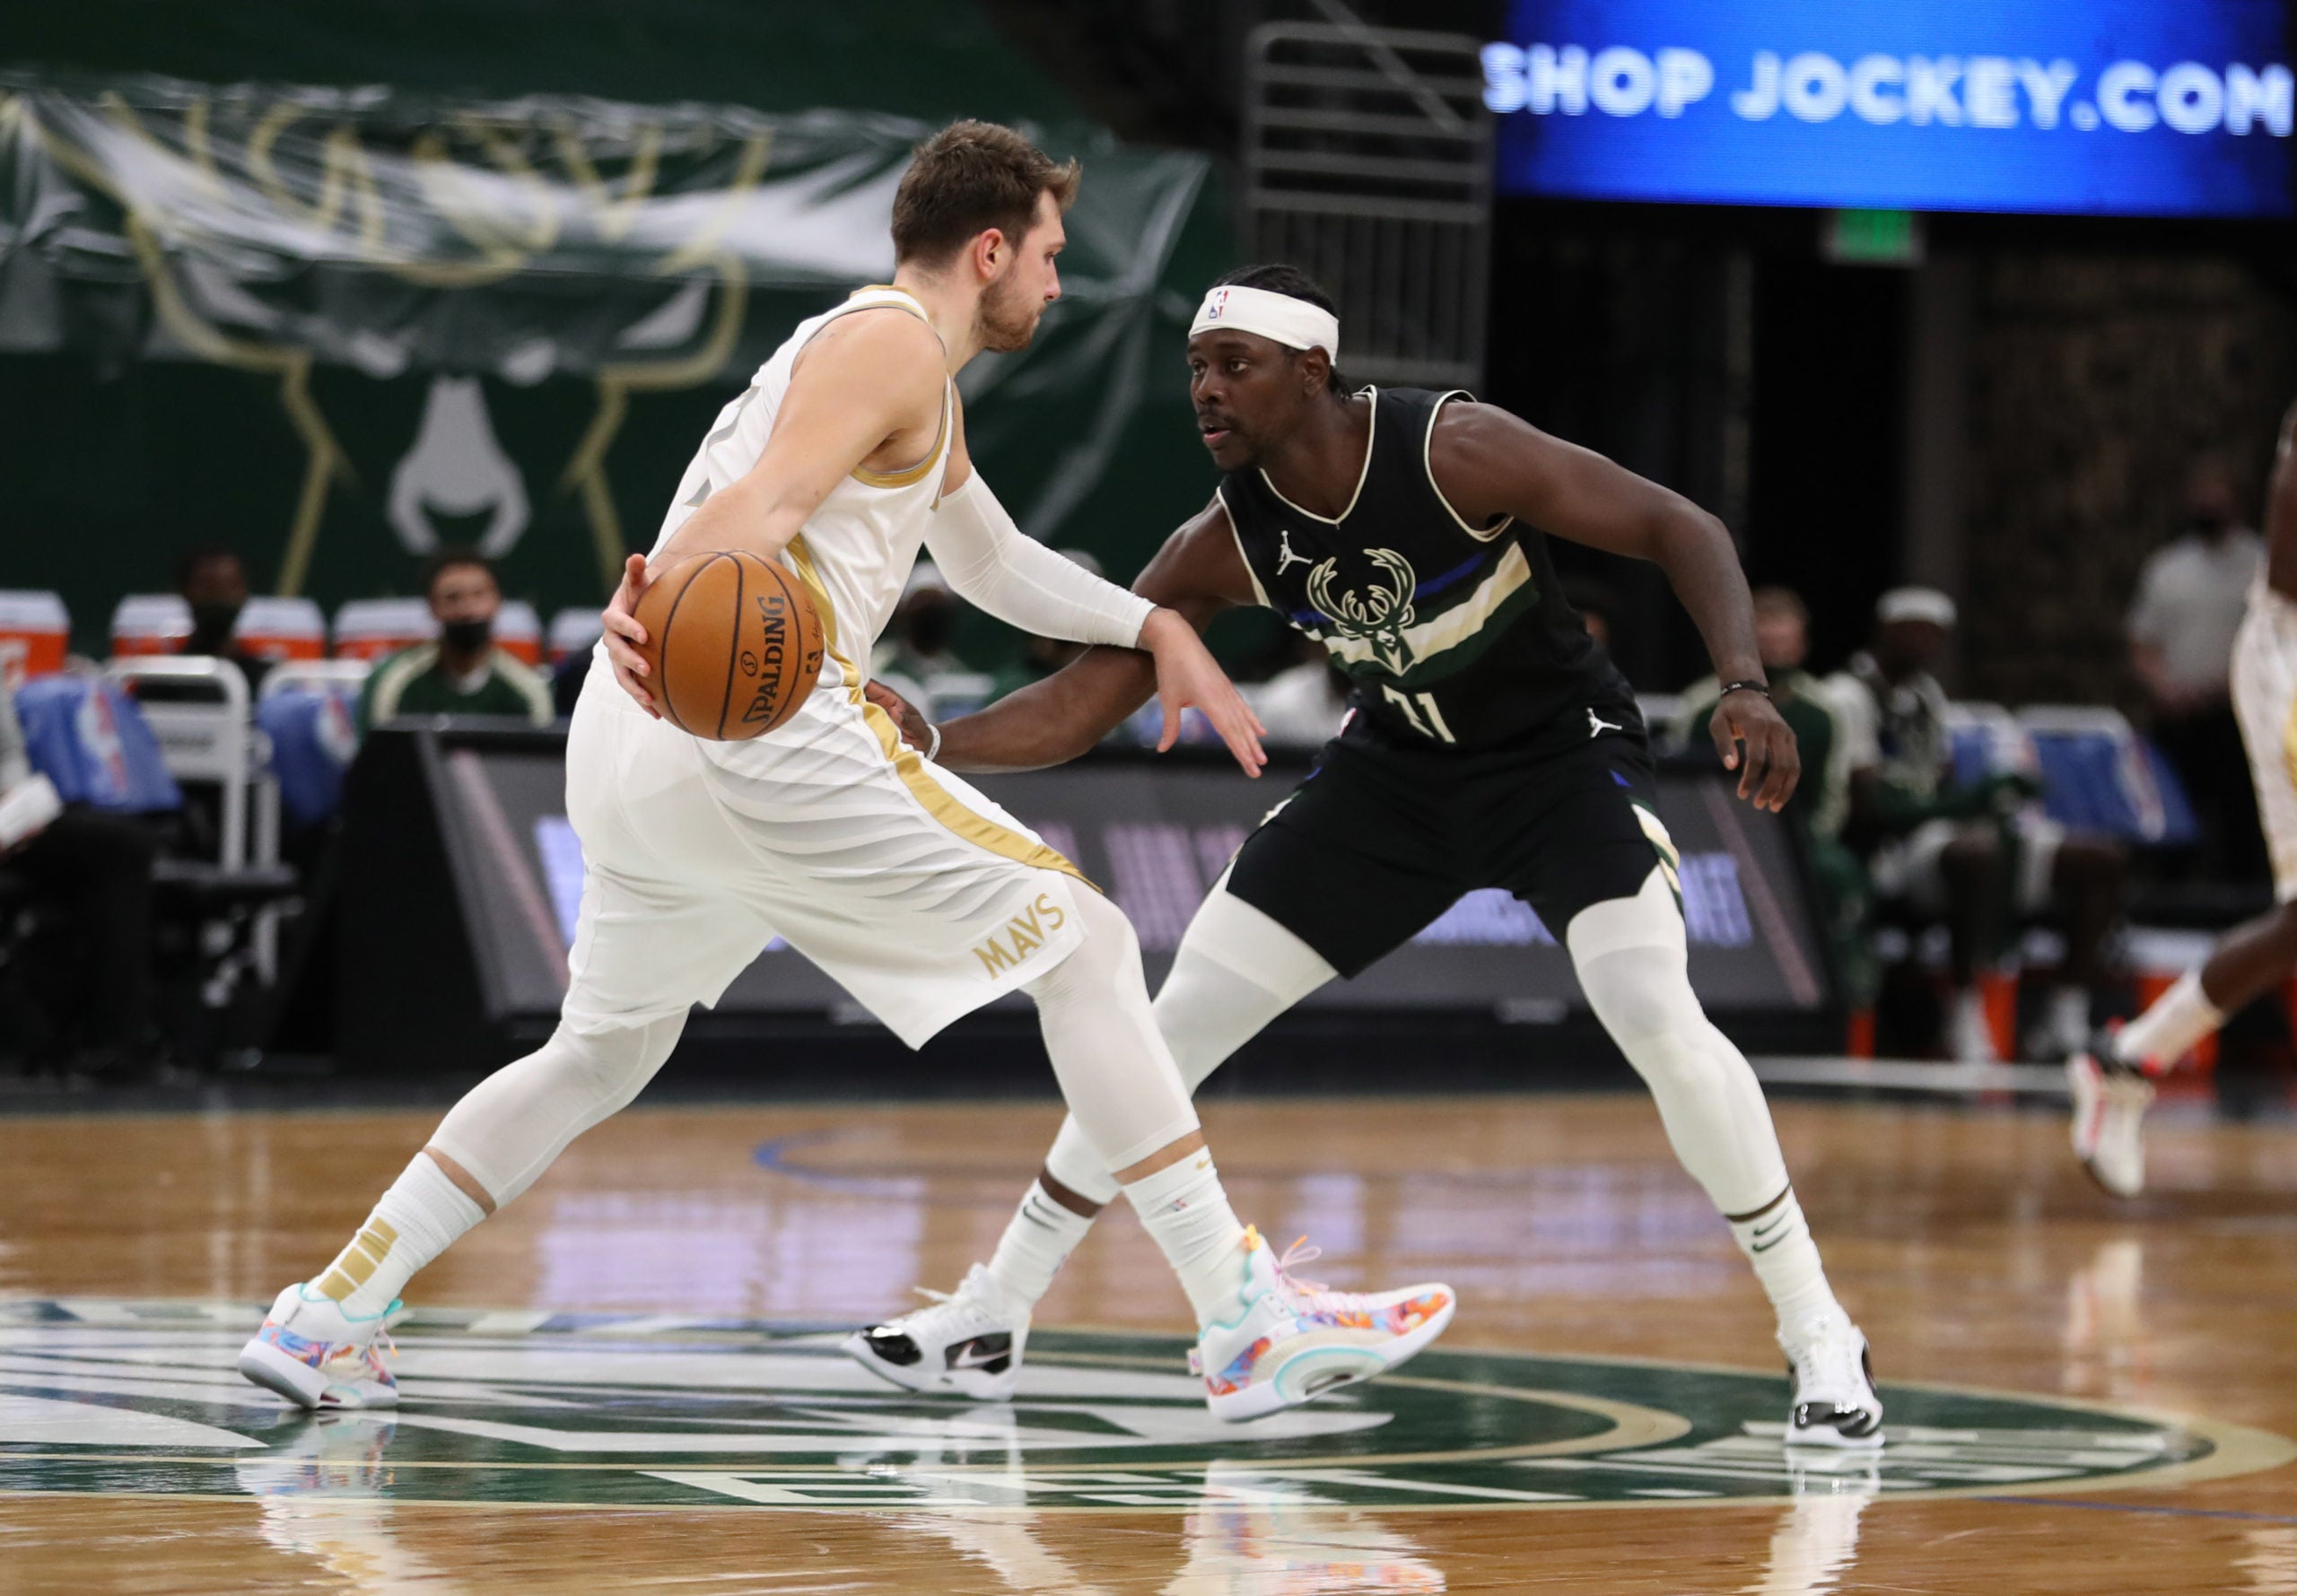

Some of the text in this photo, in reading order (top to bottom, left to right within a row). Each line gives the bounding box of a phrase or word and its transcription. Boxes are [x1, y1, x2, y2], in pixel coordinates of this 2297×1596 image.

[1481, 42, 2293, 137] SHOP JOCKEY.COM
[742, 596, 786, 724] SPALDING
[972, 893, 1065, 981] MAVS
